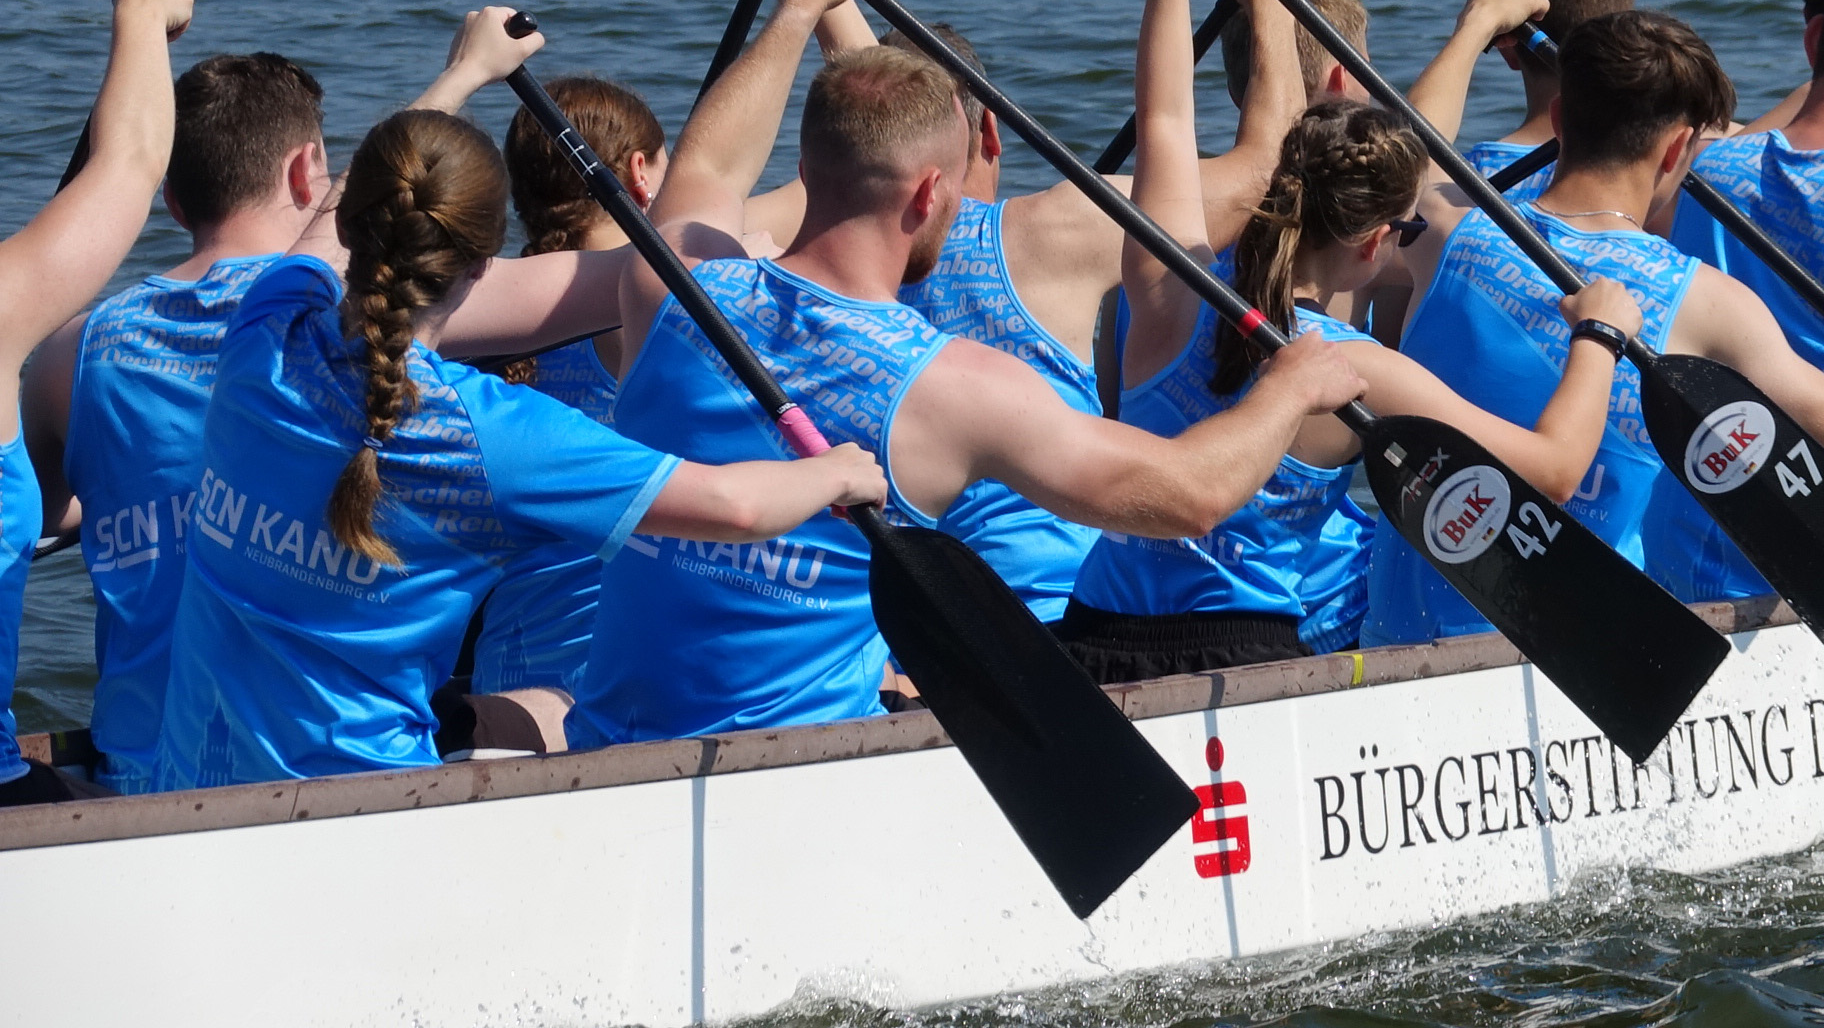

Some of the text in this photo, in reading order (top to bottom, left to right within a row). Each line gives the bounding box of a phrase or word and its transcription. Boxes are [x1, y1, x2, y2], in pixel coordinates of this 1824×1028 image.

[1560, 234, 1672, 280] Jugend
[795, 288, 916, 349] Jugend
[1702, 418, 1761, 479] BuK
[1774, 438, 1824, 499] 47
[96, 499, 159, 561] SCN
[198, 467, 247, 535] SCN
[1440, 483, 1497, 548] BuK
[1505, 501, 1562, 560] 42
[245, 545, 391, 606] NEUBRANDENBURG e.V.
[671, 553, 832, 612] NEUBRANDENBURG e.V.
